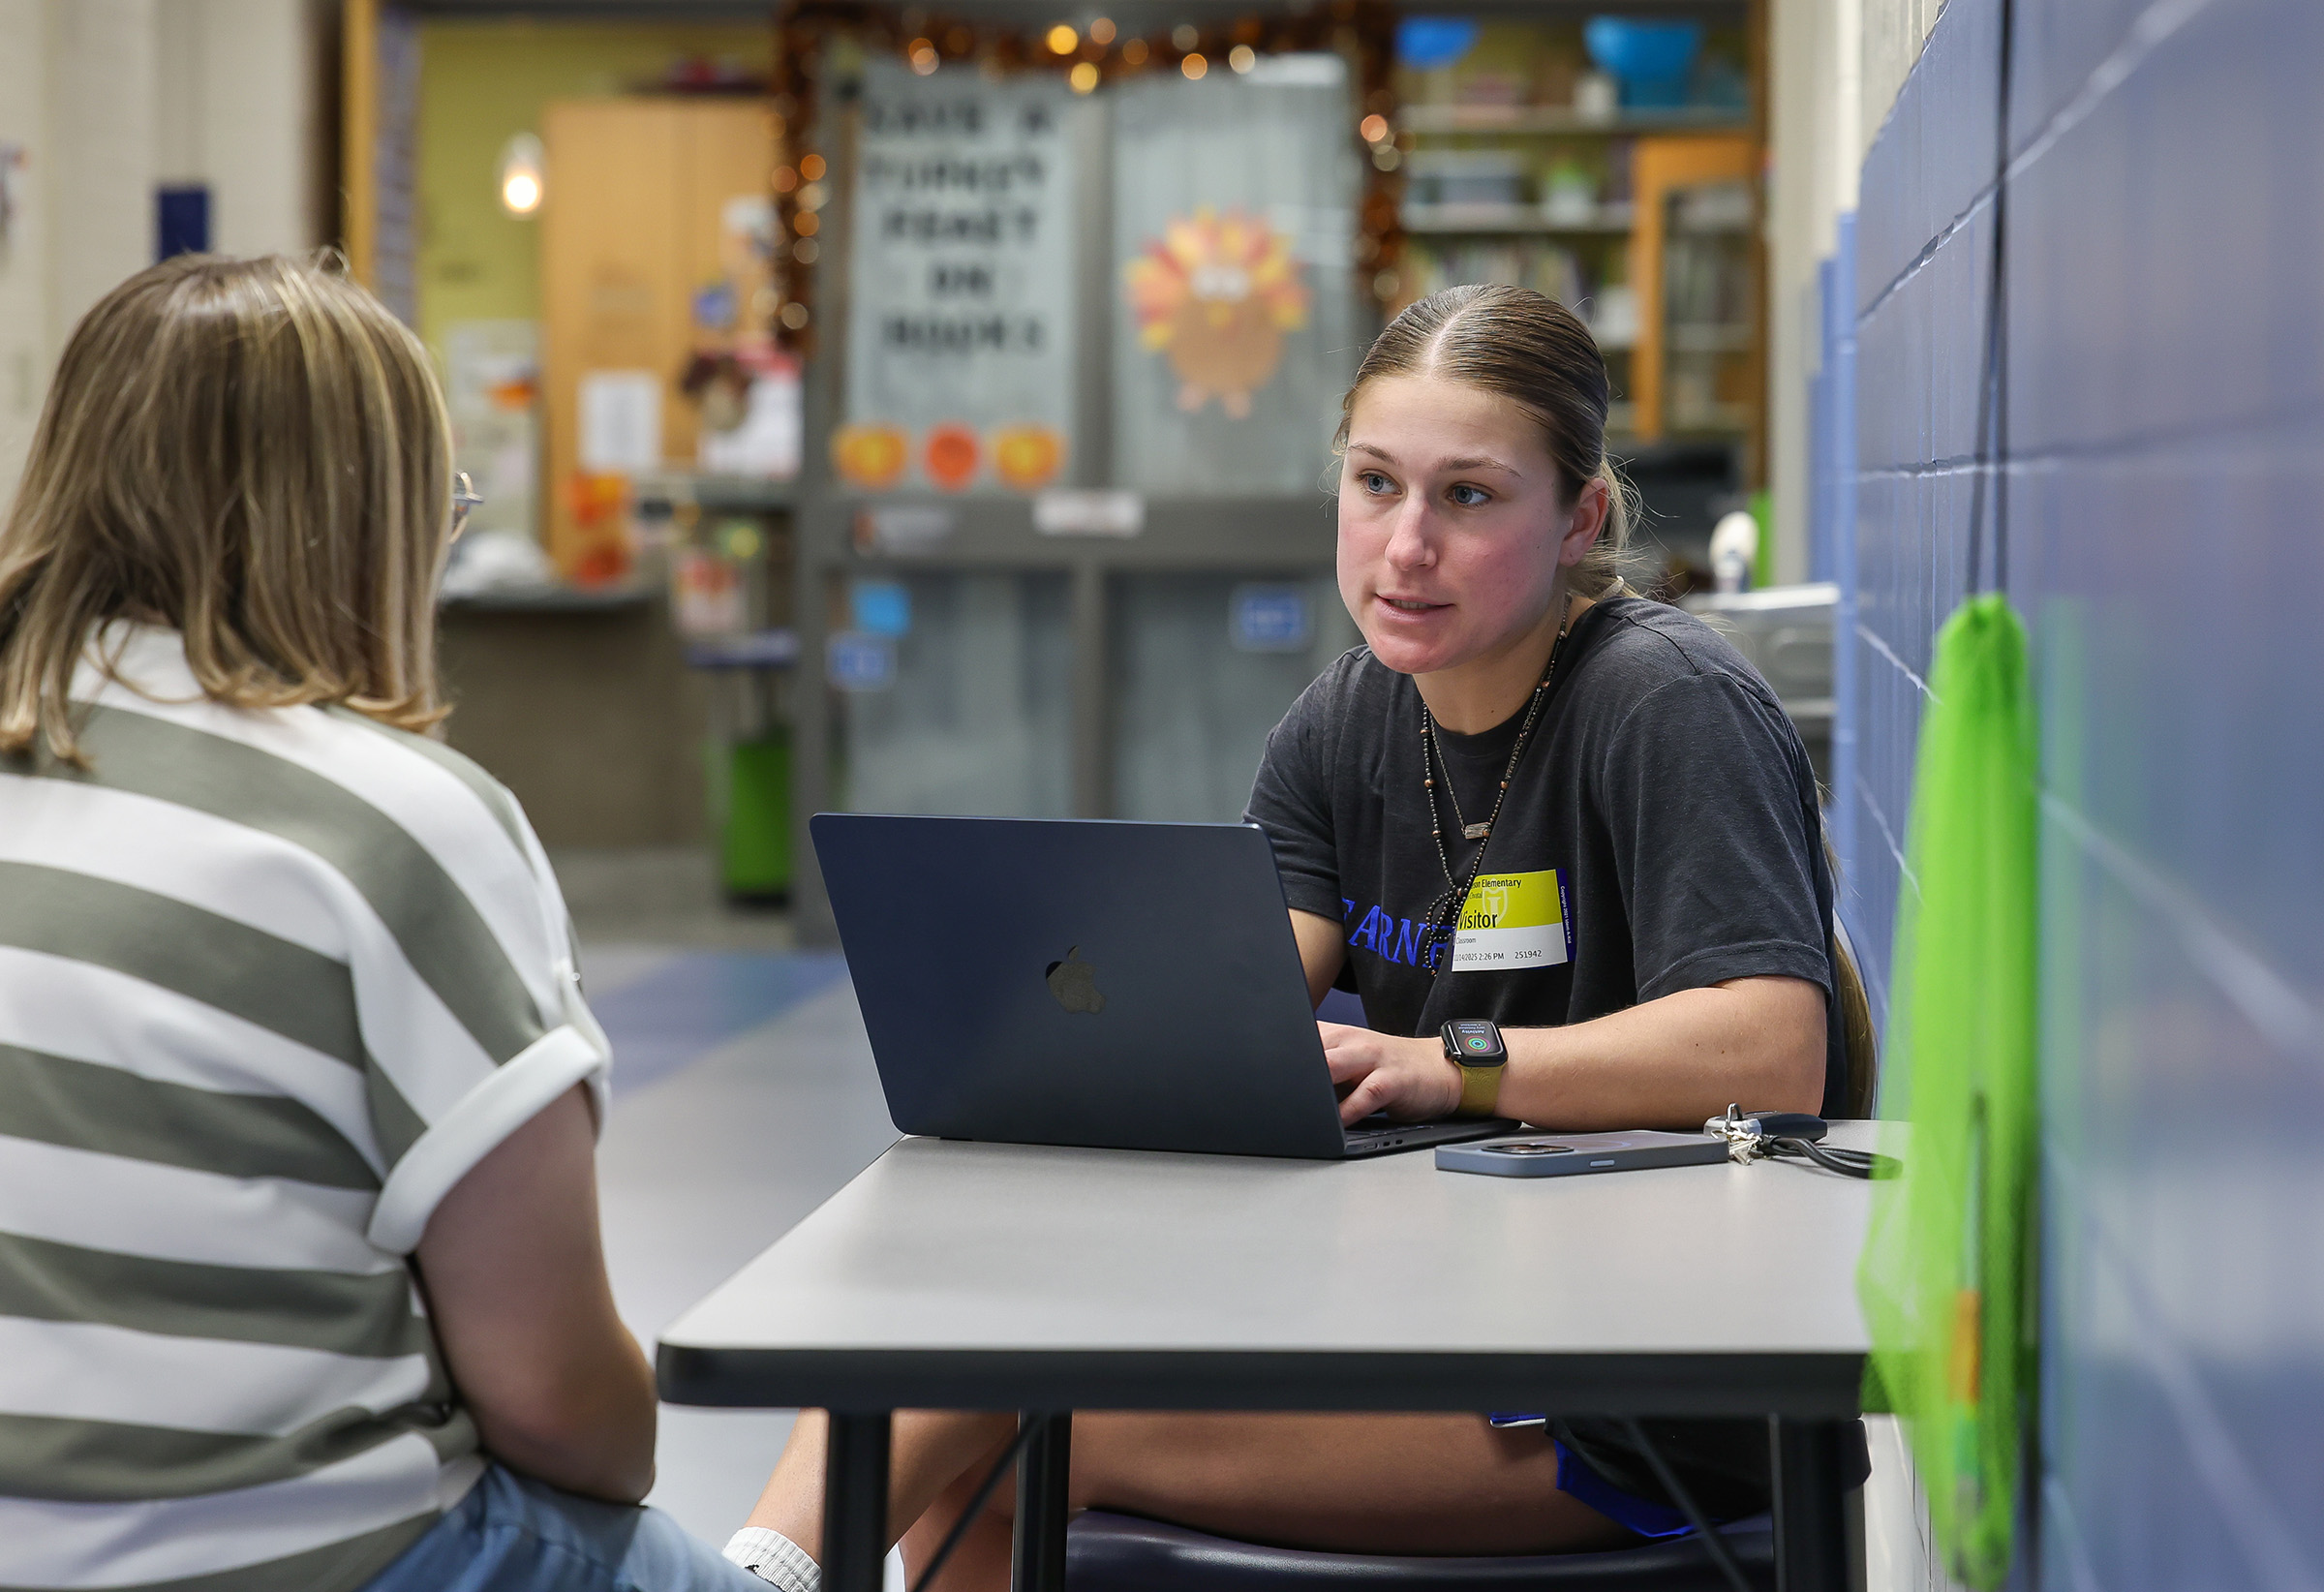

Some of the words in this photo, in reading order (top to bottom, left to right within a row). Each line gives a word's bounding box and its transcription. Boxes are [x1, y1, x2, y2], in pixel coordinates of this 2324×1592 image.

[1482, 878, 1522, 888] Elementary
[1459, 909, 1498, 929] Visitor
[1479, 952, 1492, 961] 2:26
[1514, 949, 1543, 959] 251942
